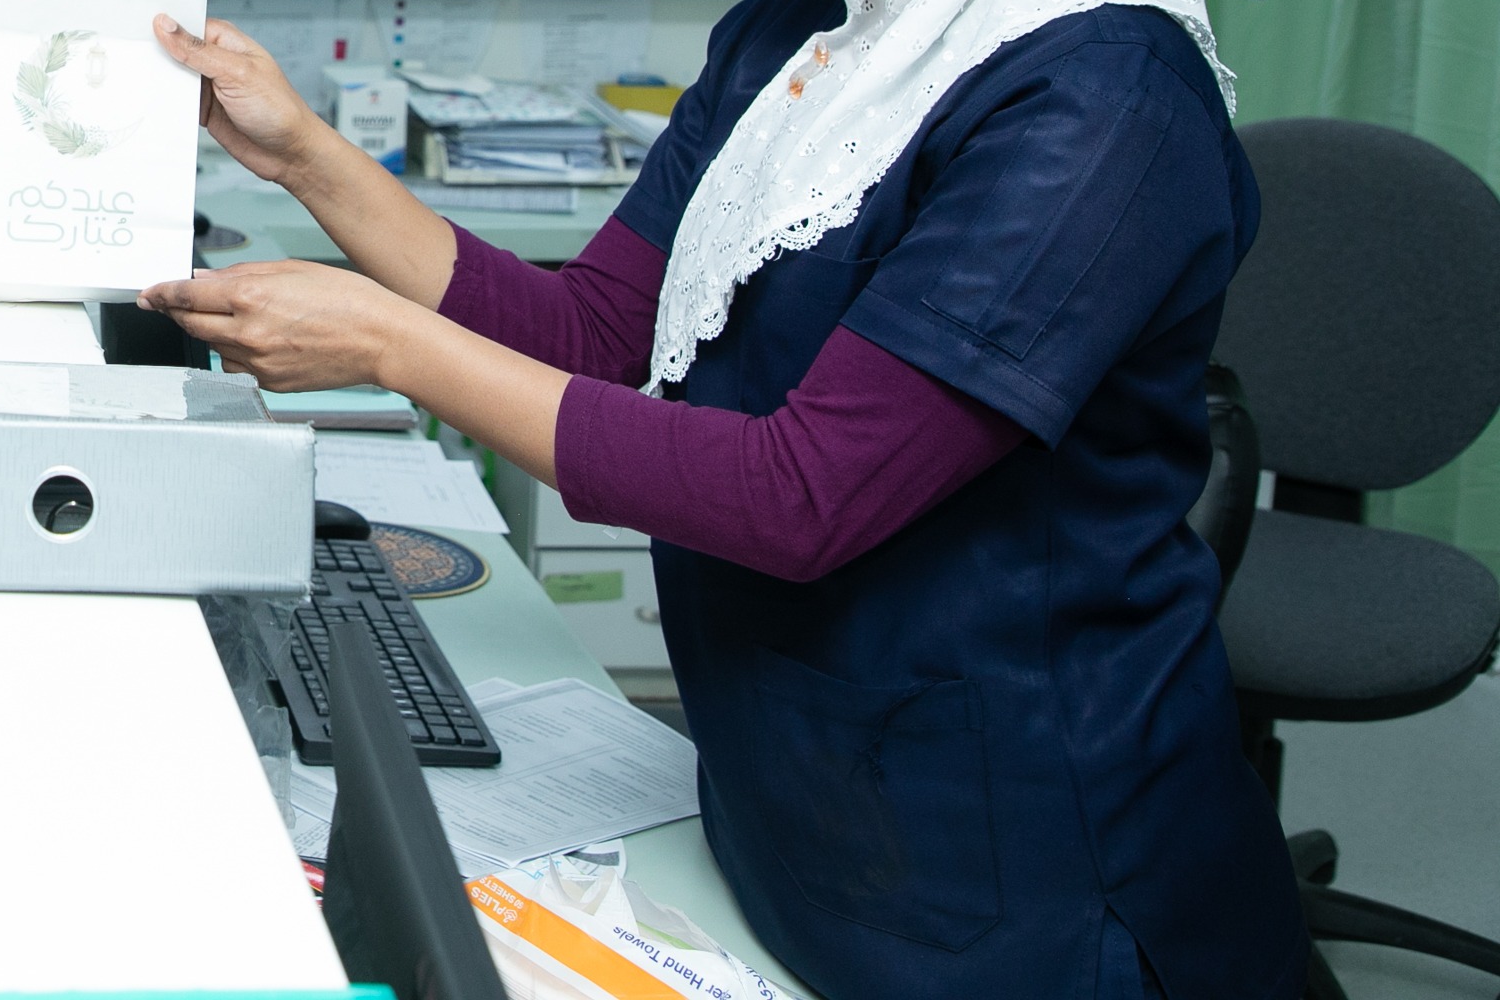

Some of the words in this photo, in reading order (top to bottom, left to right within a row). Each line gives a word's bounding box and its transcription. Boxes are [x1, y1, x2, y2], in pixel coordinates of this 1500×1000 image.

[470, 886, 507, 916] PLIES
[612, 926, 661, 963] Towels
[662, 956, 704, 990] Hand
